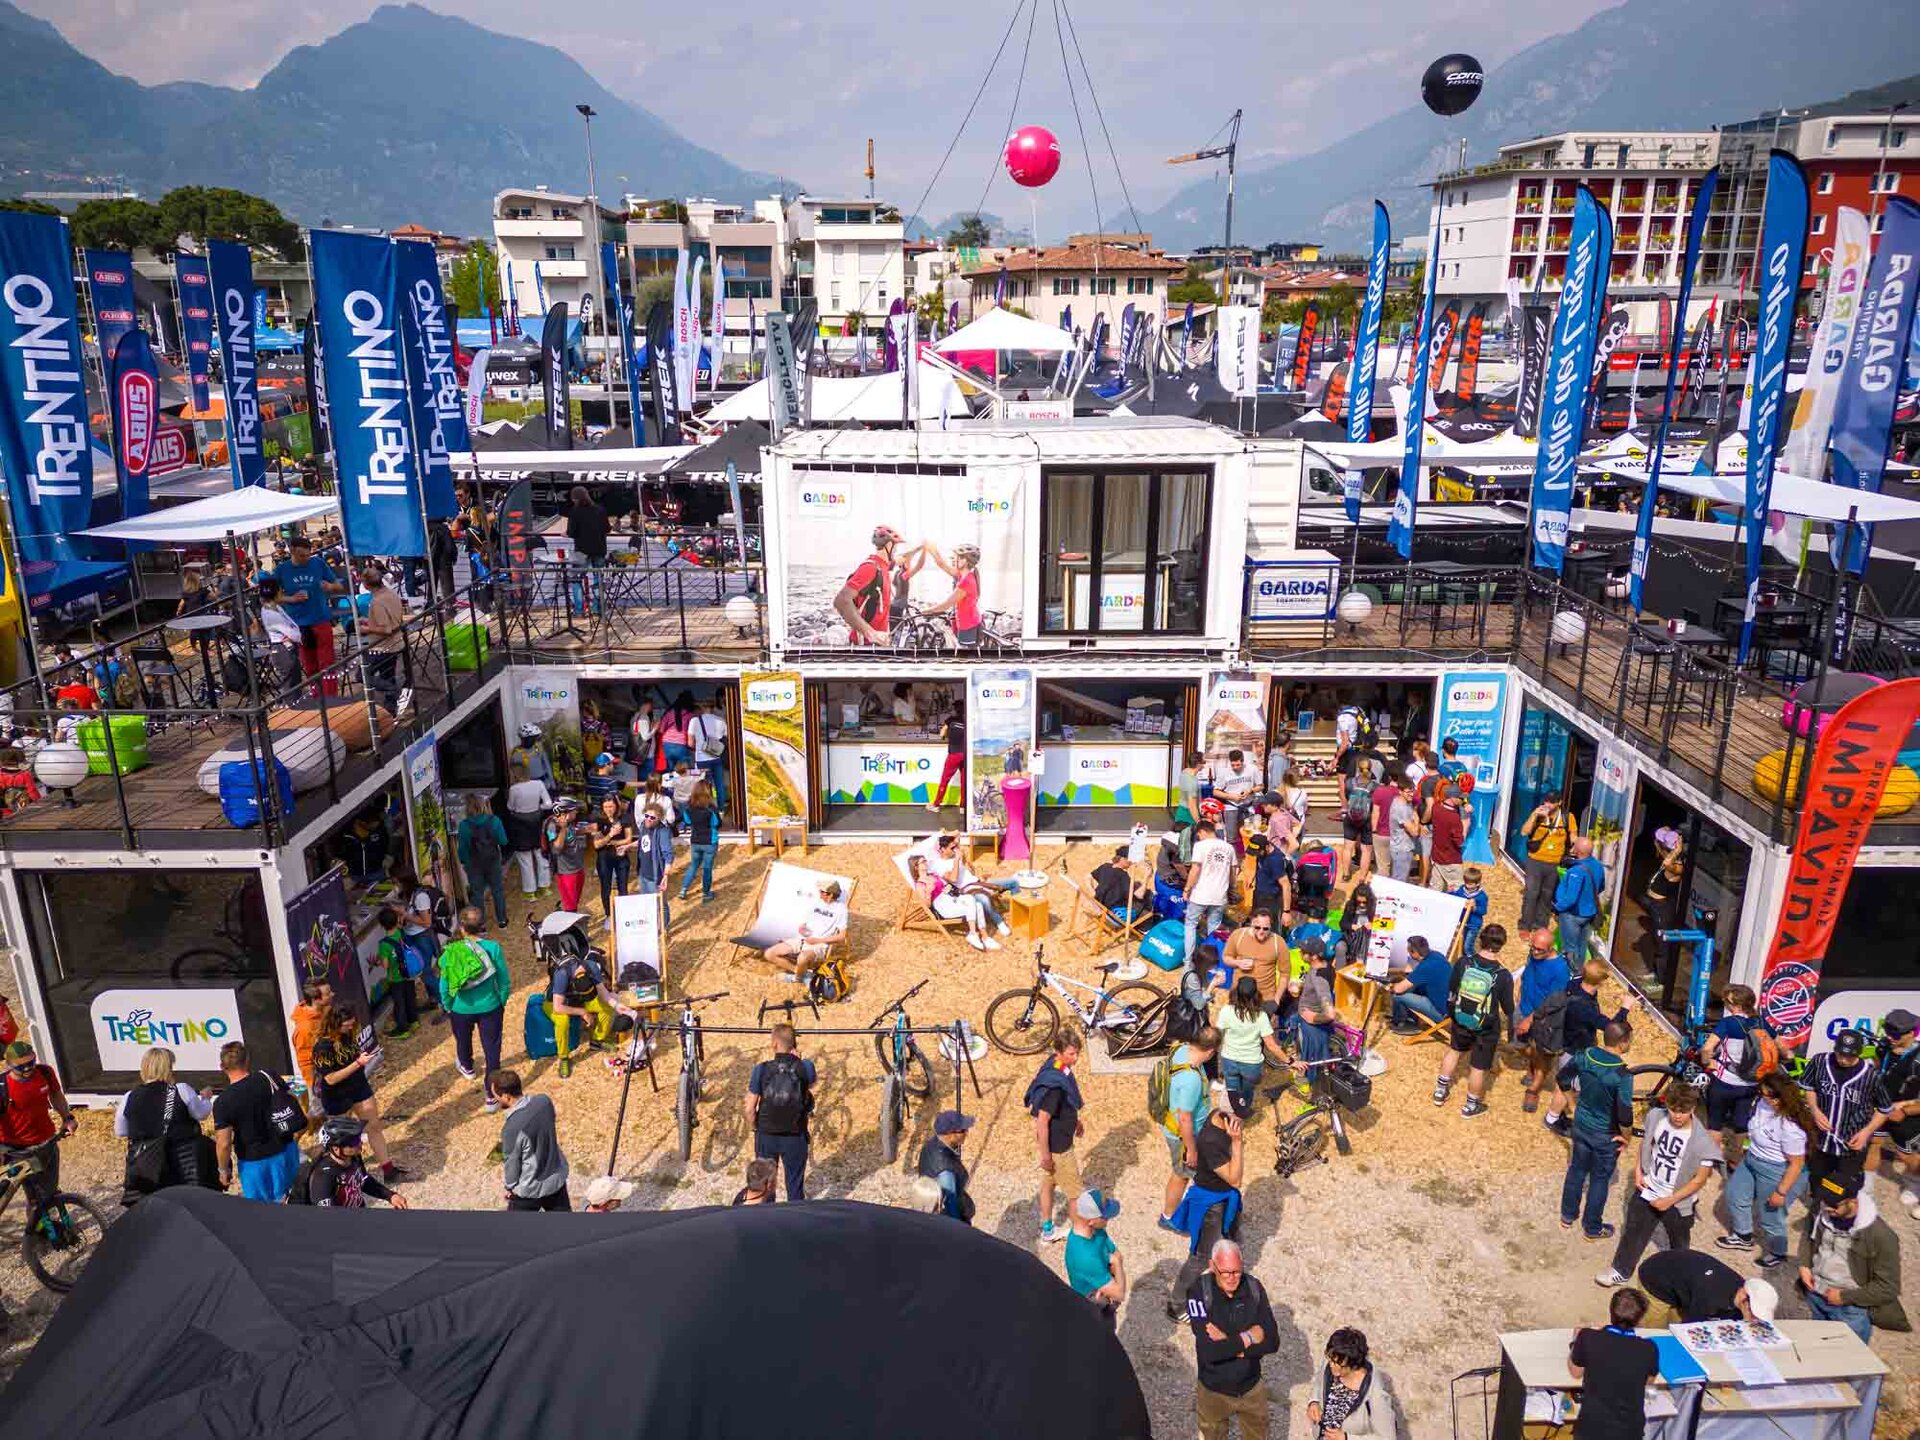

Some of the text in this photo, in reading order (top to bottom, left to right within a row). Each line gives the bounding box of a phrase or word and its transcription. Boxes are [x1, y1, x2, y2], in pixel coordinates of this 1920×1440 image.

[680, 307, 688, 343] BOSCH
[415, 279, 461, 420] TRENTINO
[225, 288, 259, 456] TRENTINO
[1693, 329, 1710, 400] CONWAY
[486, 371, 519, 384] uvex
[4, 273, 86, 506] TRENTINO
[552, 345, 566, 432] TREK
[655, 345, 675, 429] TREK
[343, 290, 410, 505] TRENTINO
[469, 395, 479, 424] BOSCH
[1029, 411, 1060, 419] BOSCH
[129, 383, 147, 462] ABUS
[1460, 423, 1496, 432] evoc
[453, 469, 533, 481] TREK
[568, 470, 648, 482] TREK
[687, 471, 764, 484] TREK
[803, 492, 846, 504] GARDA
[968, 499, 1009, 513] TRENTINO
[1259, 581, 1329, 596] GARDA
[525, 688, 568, 700] TRENTINO
[751, 690, 793, 703] TRENTINO
[982, 689, 1020, 699] GARDA
[1219, 690, 1258, 700] GARDA
[1453, 691, 1493, 701] GARDA
[860, 755, 930, 775] TRENTINO
[1081, 759, 1119, 769] GARDA
[1860, 760, 1887, 813] BIRRA
[1778, 721, 1878, 951] IMPAVIDA
[102, 1015, 228, 1046] TRENTINO
